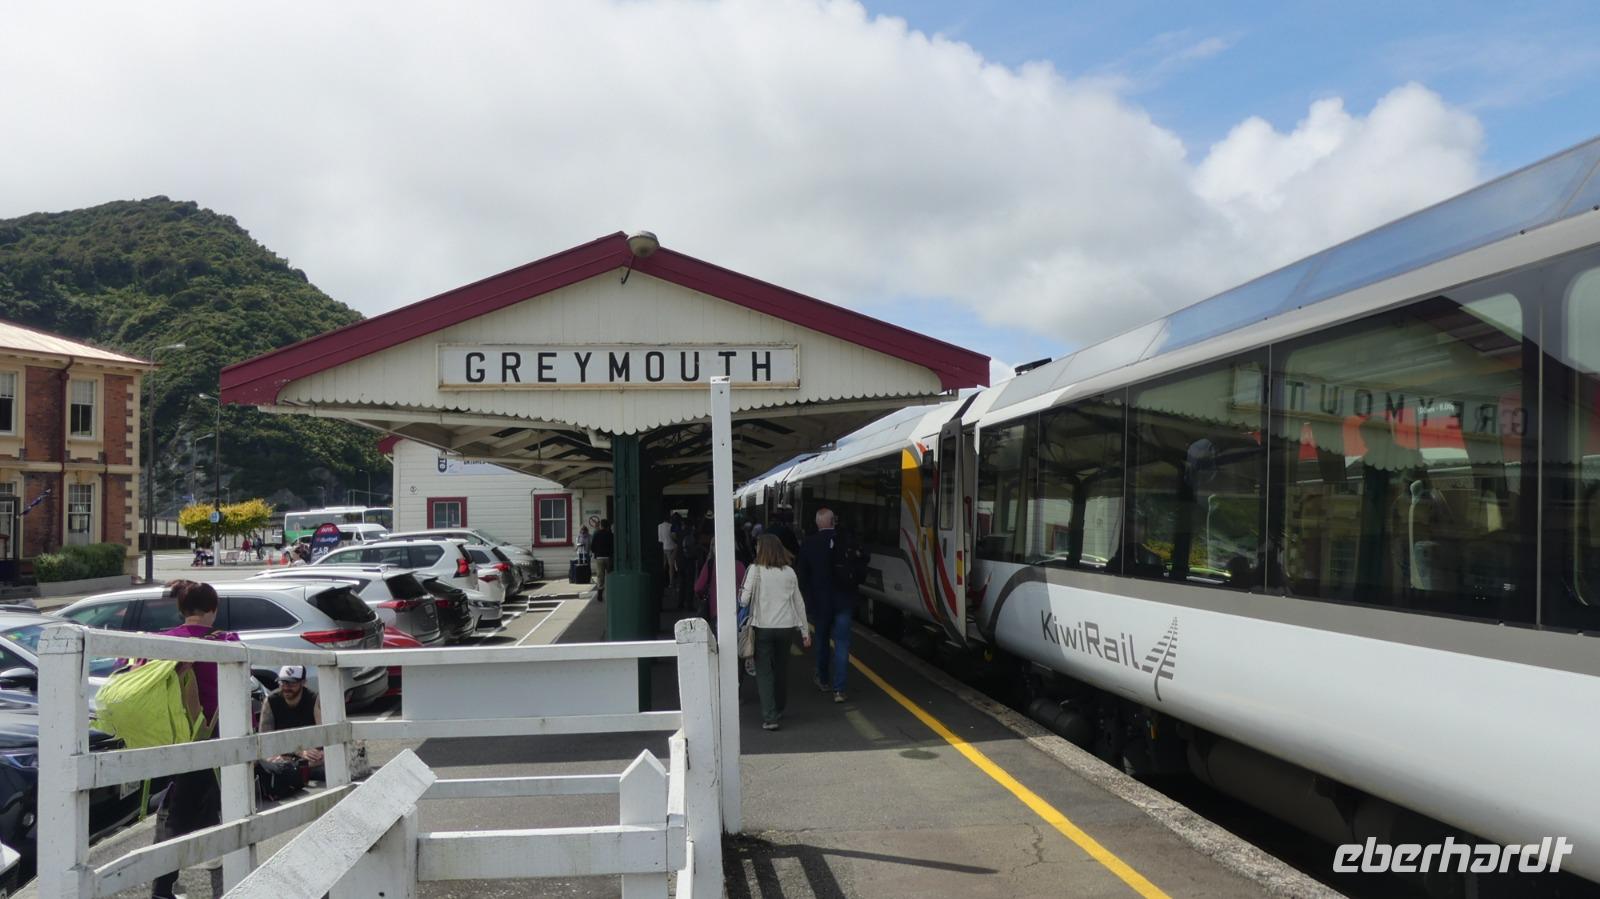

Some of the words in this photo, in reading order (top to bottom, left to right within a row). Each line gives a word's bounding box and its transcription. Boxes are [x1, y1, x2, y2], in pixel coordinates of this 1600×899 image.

[465, 352, 771, 382] GREYMOUTH
[312, 546, 329, 555] CAR
[1041, 610, 1140, 670] KiwiRail
